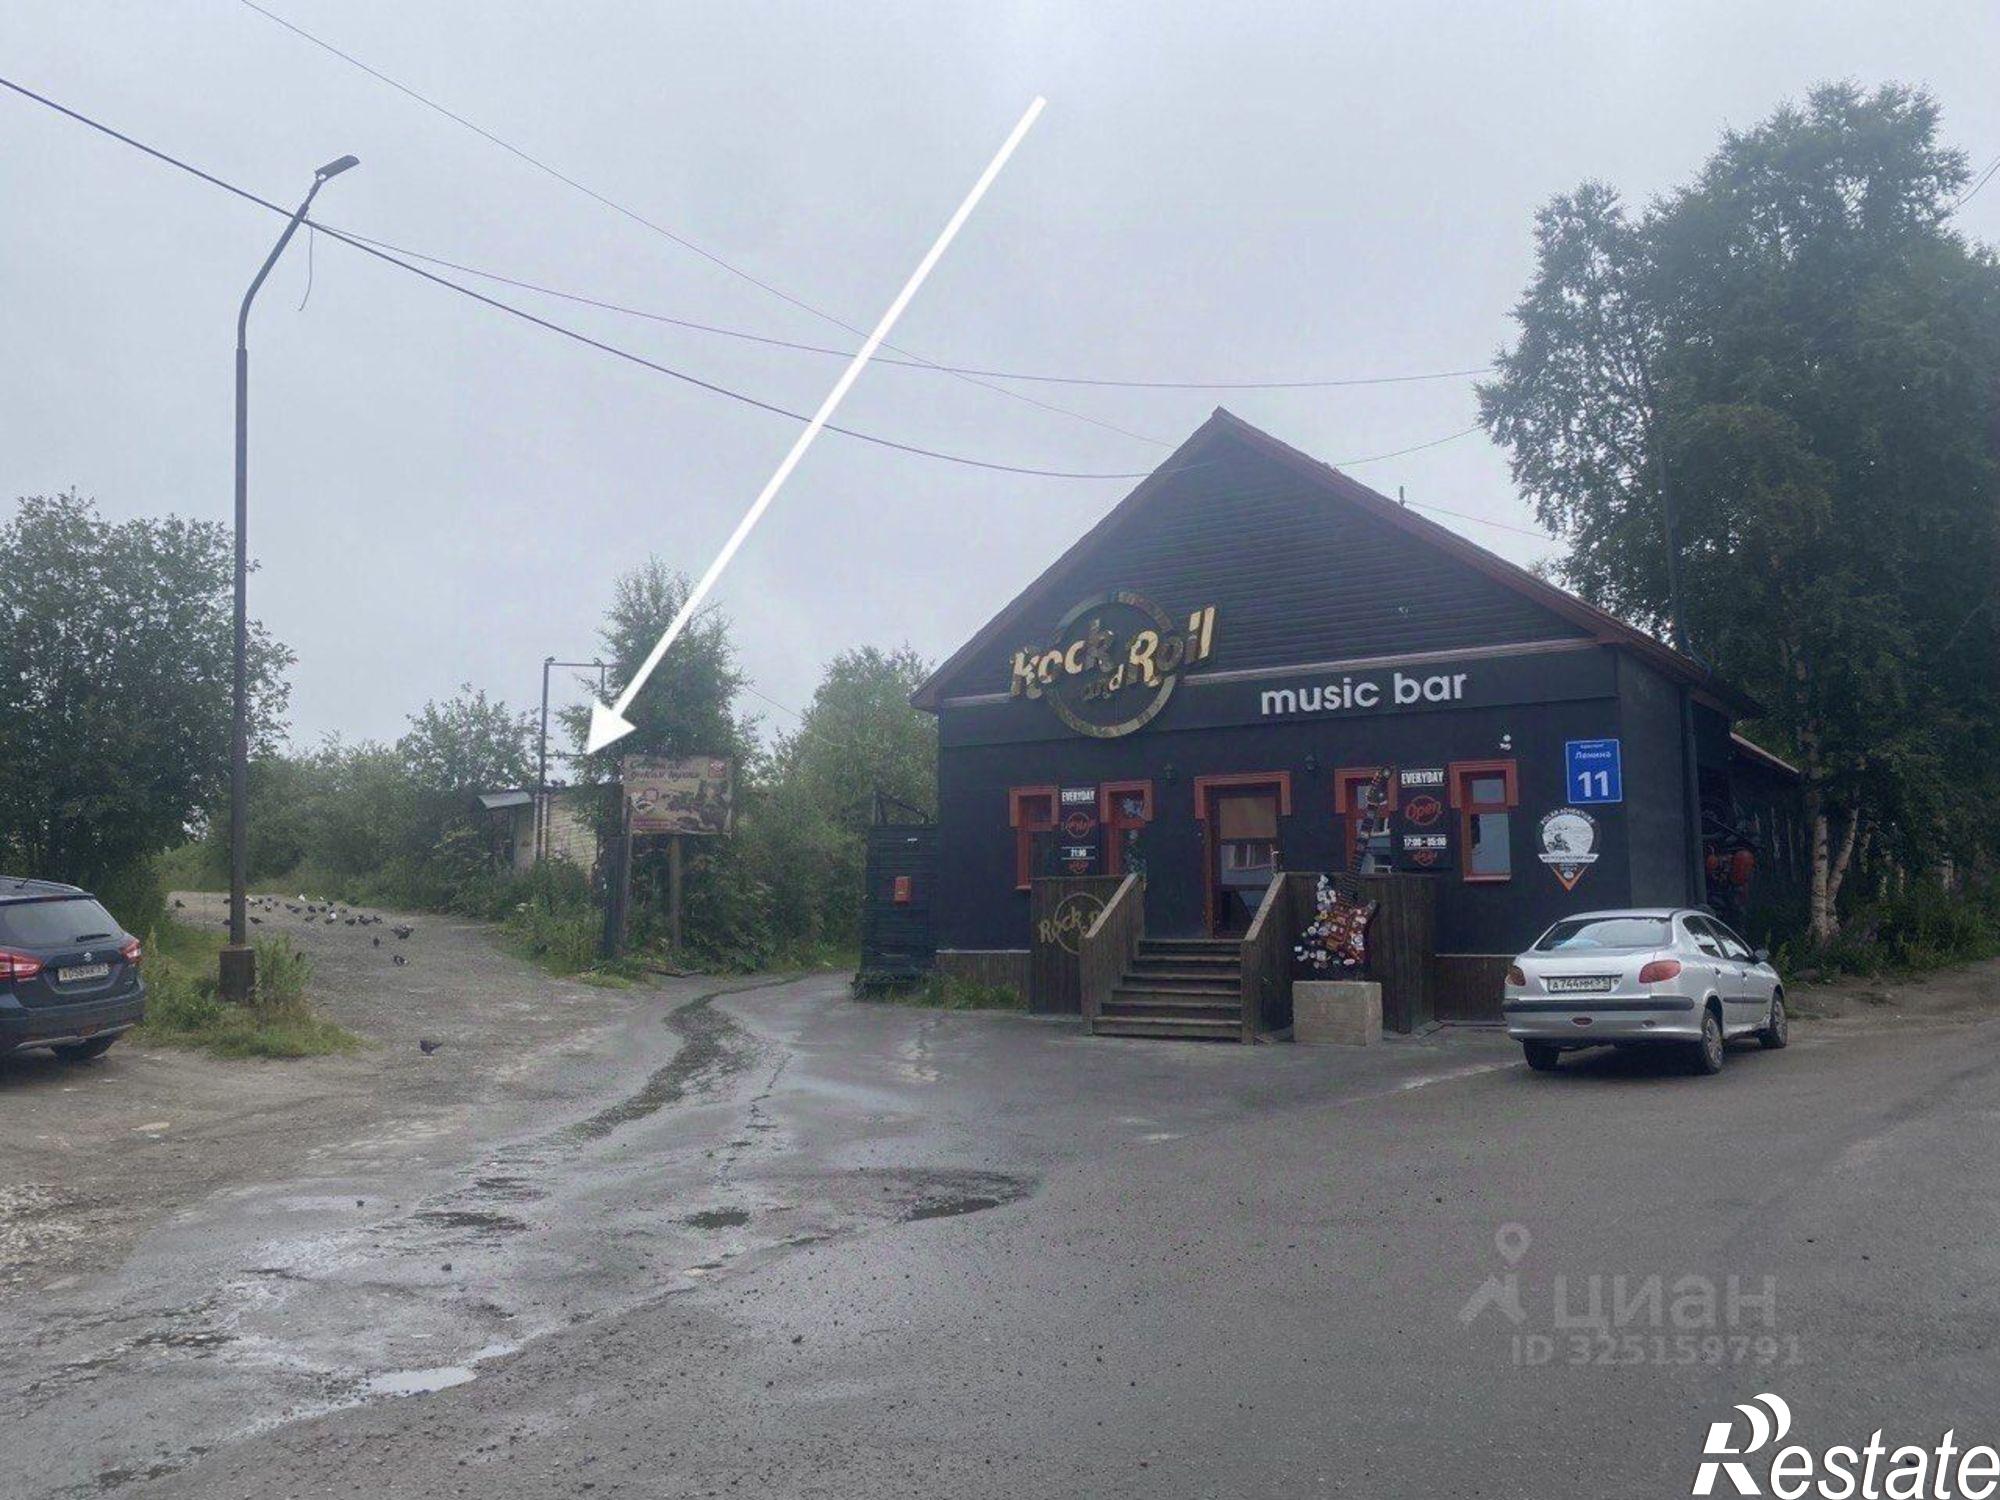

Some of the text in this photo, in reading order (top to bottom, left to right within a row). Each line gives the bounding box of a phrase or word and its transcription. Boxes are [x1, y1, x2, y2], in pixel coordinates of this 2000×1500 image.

[1261, 672, 1467, 715] music bar
[1575, 750, 1612, 760] Ленина
[1401, 771, 1444, 784] EVERYDAY
[1577, 769, 1609, 798] 11
[1061, 790, 1096, 802] EVERYDAY
[1039, 906, 1082, 943] Rock
